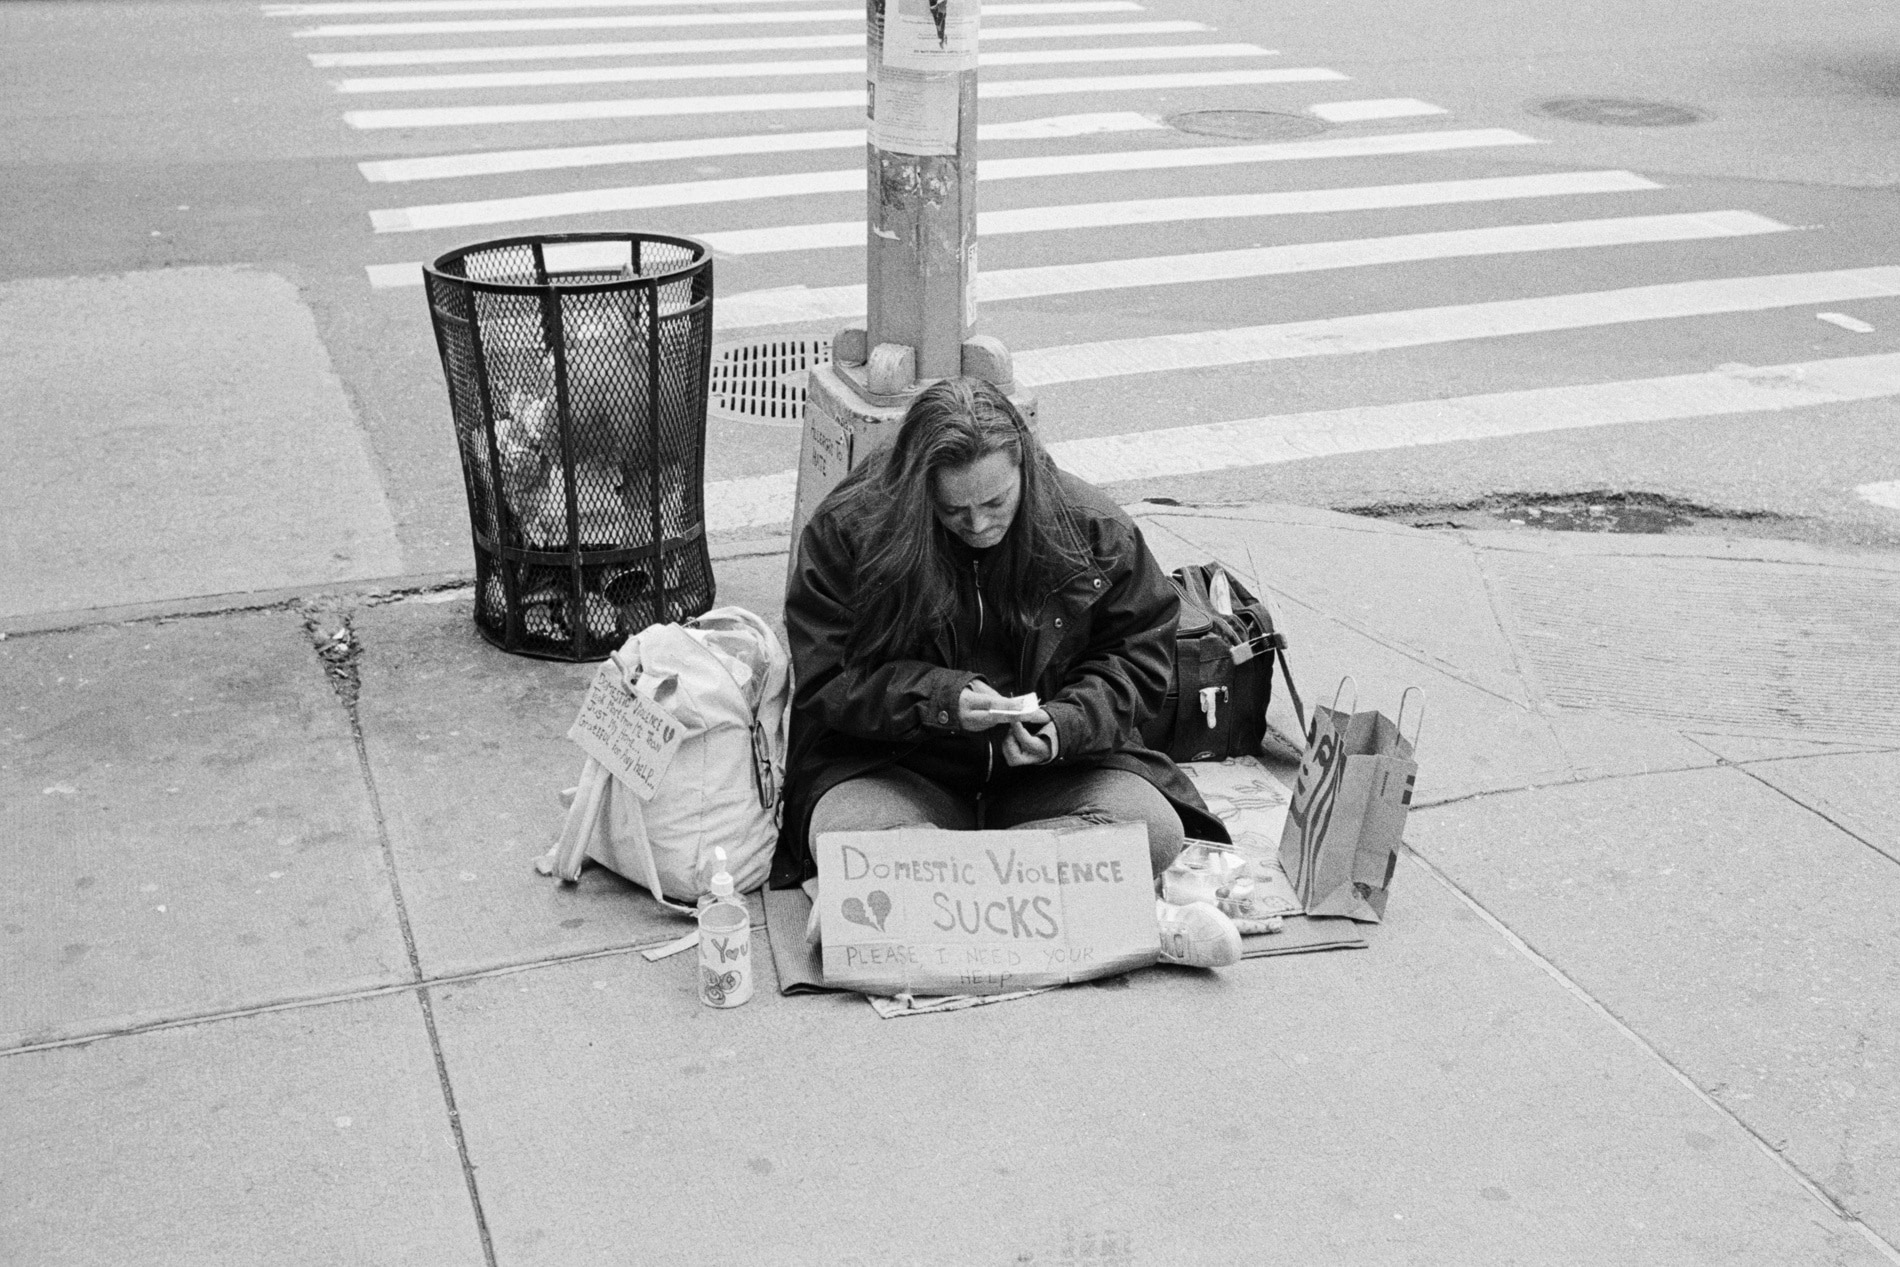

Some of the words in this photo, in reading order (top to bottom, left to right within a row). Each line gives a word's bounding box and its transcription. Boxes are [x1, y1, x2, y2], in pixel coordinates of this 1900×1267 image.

[933, 891, 1059, 940] SUCKS
[935, 947, 949, 964] I
[966, 947, 1021, 966] NEED
[1043, 947, 1094, 970] YOUR
[960, 969, 1013, 987] HELP
